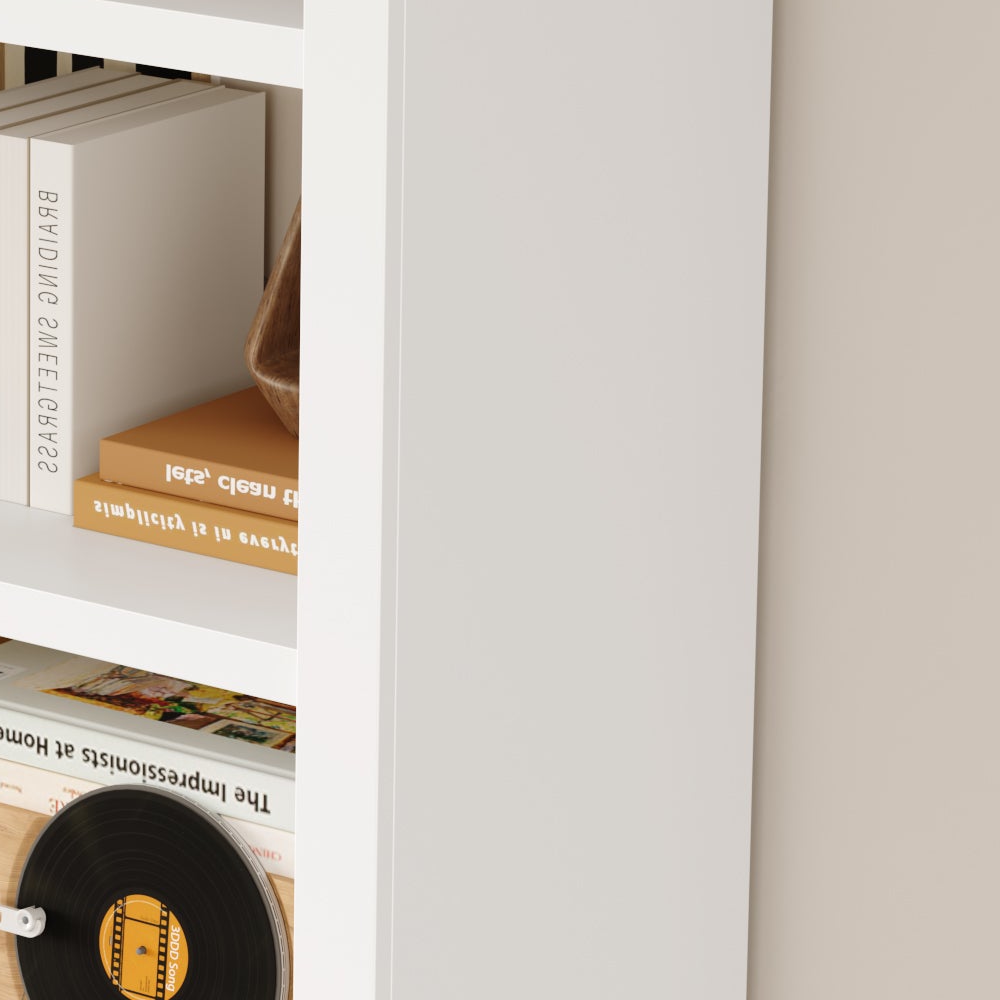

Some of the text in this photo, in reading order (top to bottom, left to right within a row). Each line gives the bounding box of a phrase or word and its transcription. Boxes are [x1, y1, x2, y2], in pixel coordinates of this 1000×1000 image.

[56, 740, 74, 760] at
[82, 747, 226, 802] Impressionists
[235, 784, 271, 814] The
[166, 924, 181, 992] 3DDD Song
